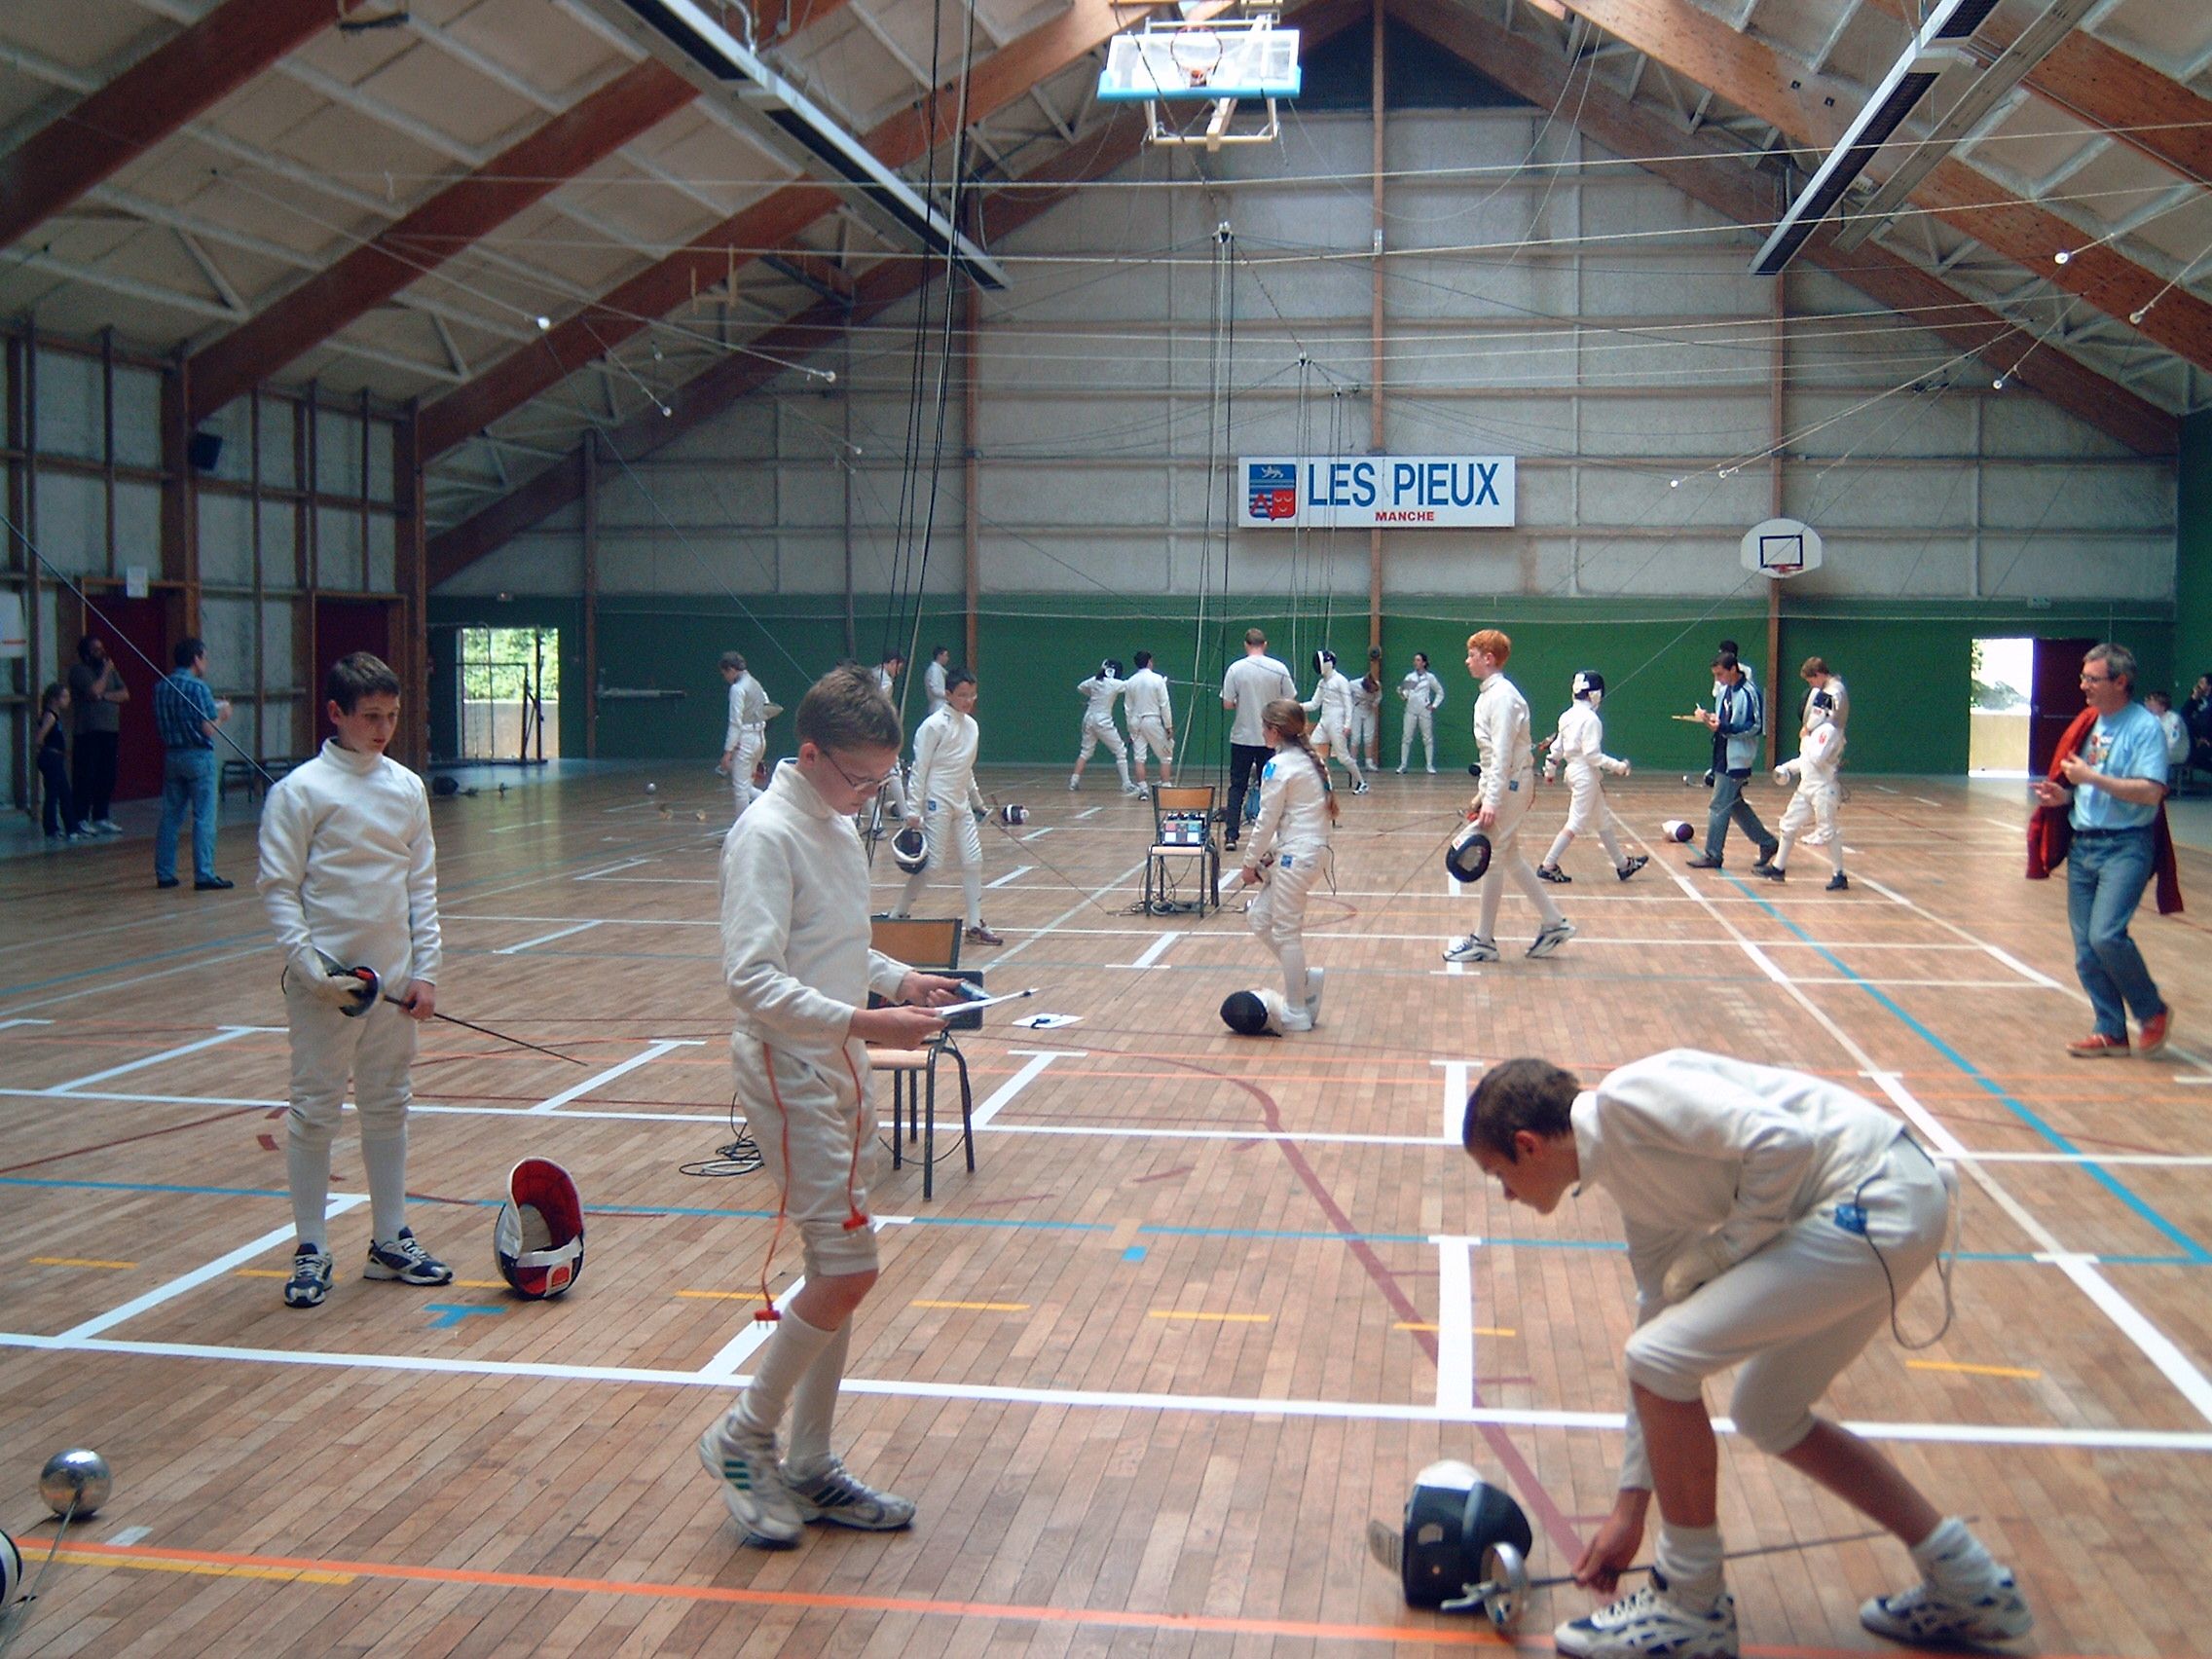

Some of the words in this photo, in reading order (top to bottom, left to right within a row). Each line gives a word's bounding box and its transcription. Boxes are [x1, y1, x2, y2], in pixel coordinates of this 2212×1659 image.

[1308, 462, 1376, 506] LES
[1393, 462, 1499, 506] PIEUX
[1375, 511, 1434, 522] MANCHE
